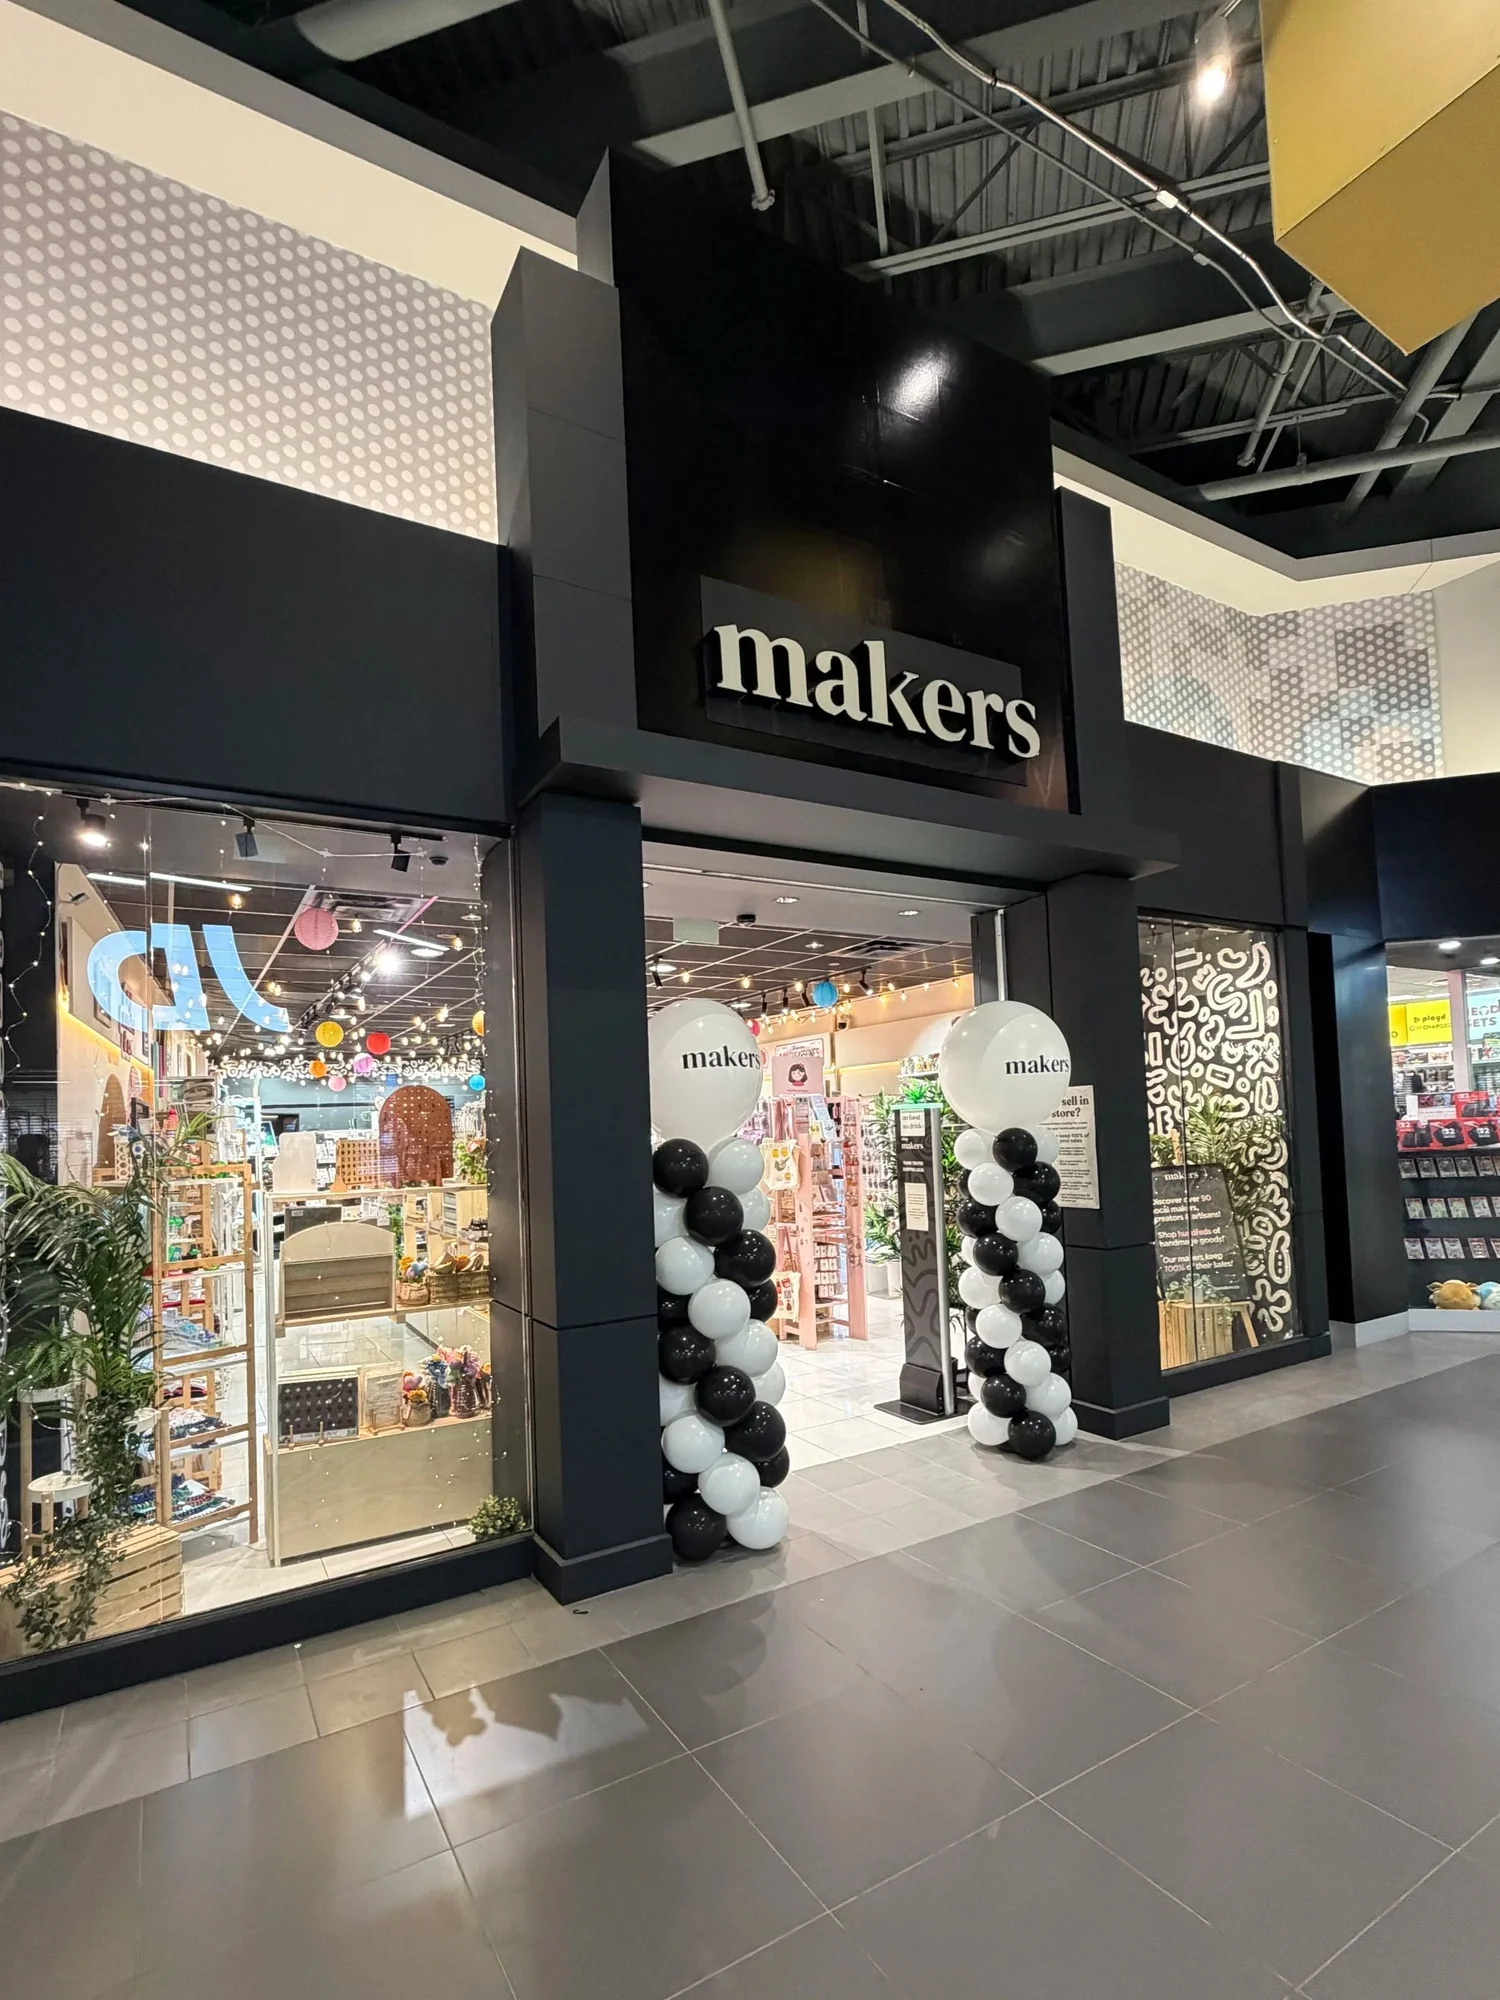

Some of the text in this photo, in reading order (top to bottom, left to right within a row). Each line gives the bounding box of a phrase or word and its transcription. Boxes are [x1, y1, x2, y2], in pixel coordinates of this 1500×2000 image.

[713, 624, 1041, 759] makers
[682, 1045, 761, 1069] makers
[1005, 1055, 1070, 1074] makers
[1061, 1095, 1089, 1106] sell in
[1051, 1107, 1081, 1117] store?
[901, 1142, 924, 1150] makers
[1164, 1171, 1199, 1181] makrs
[1200, 1194, 1212, 1202] 90
[1157, 1231, 1177, 1239] Shop
[1212, 1226, 1221, 1235] of
[1162, 1255, 1177, 1264] Our
[1164, 1264, 1185, 1272] 100%
